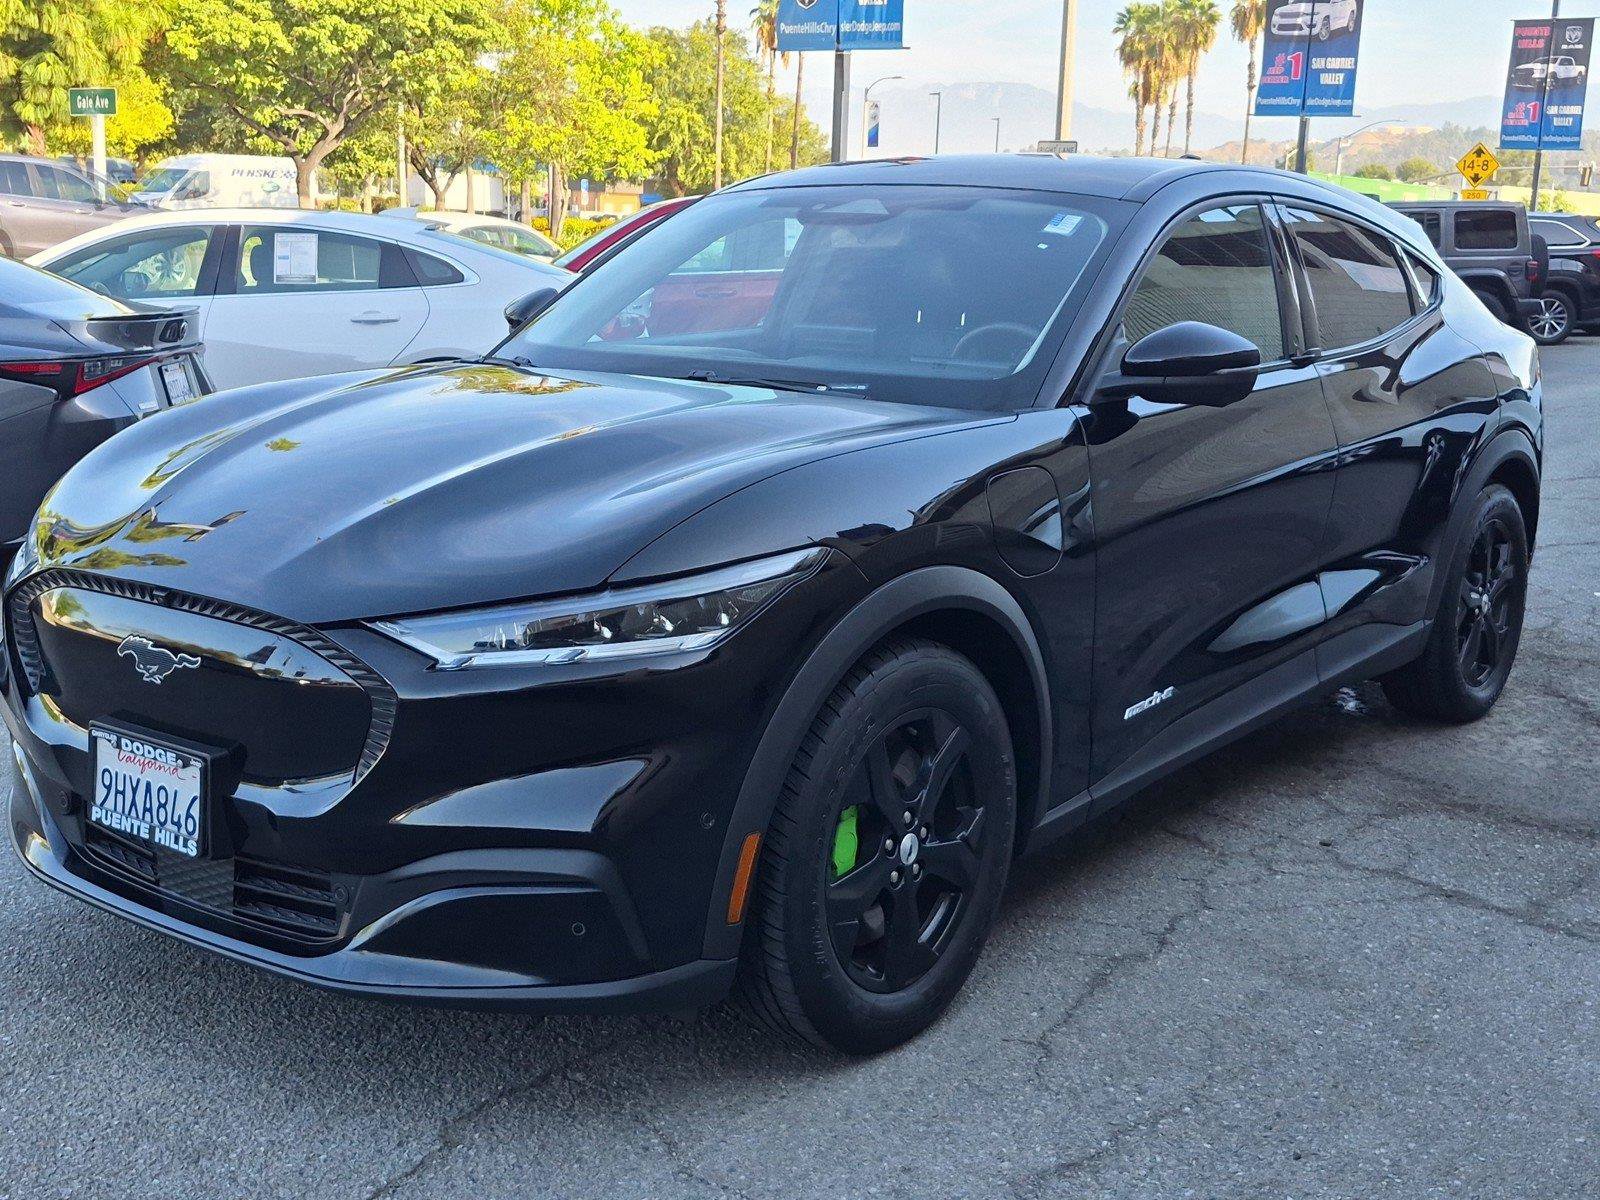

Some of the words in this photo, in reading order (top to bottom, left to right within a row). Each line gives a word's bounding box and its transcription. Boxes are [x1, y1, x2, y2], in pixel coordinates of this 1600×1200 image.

[1311, 57, 1326, 69] SAN
[1319, 73, 1345, 85] VALLEY
[76, 95, 93, 109] Gale
[95, 94, 109, 109] Ave
[121, 738, 177, 766] DODGE
[100, 767, 199, 836] 9HXA846
[91, 806, 151, 840] PUENTE
[154, 826, 198, 857] HILLS
